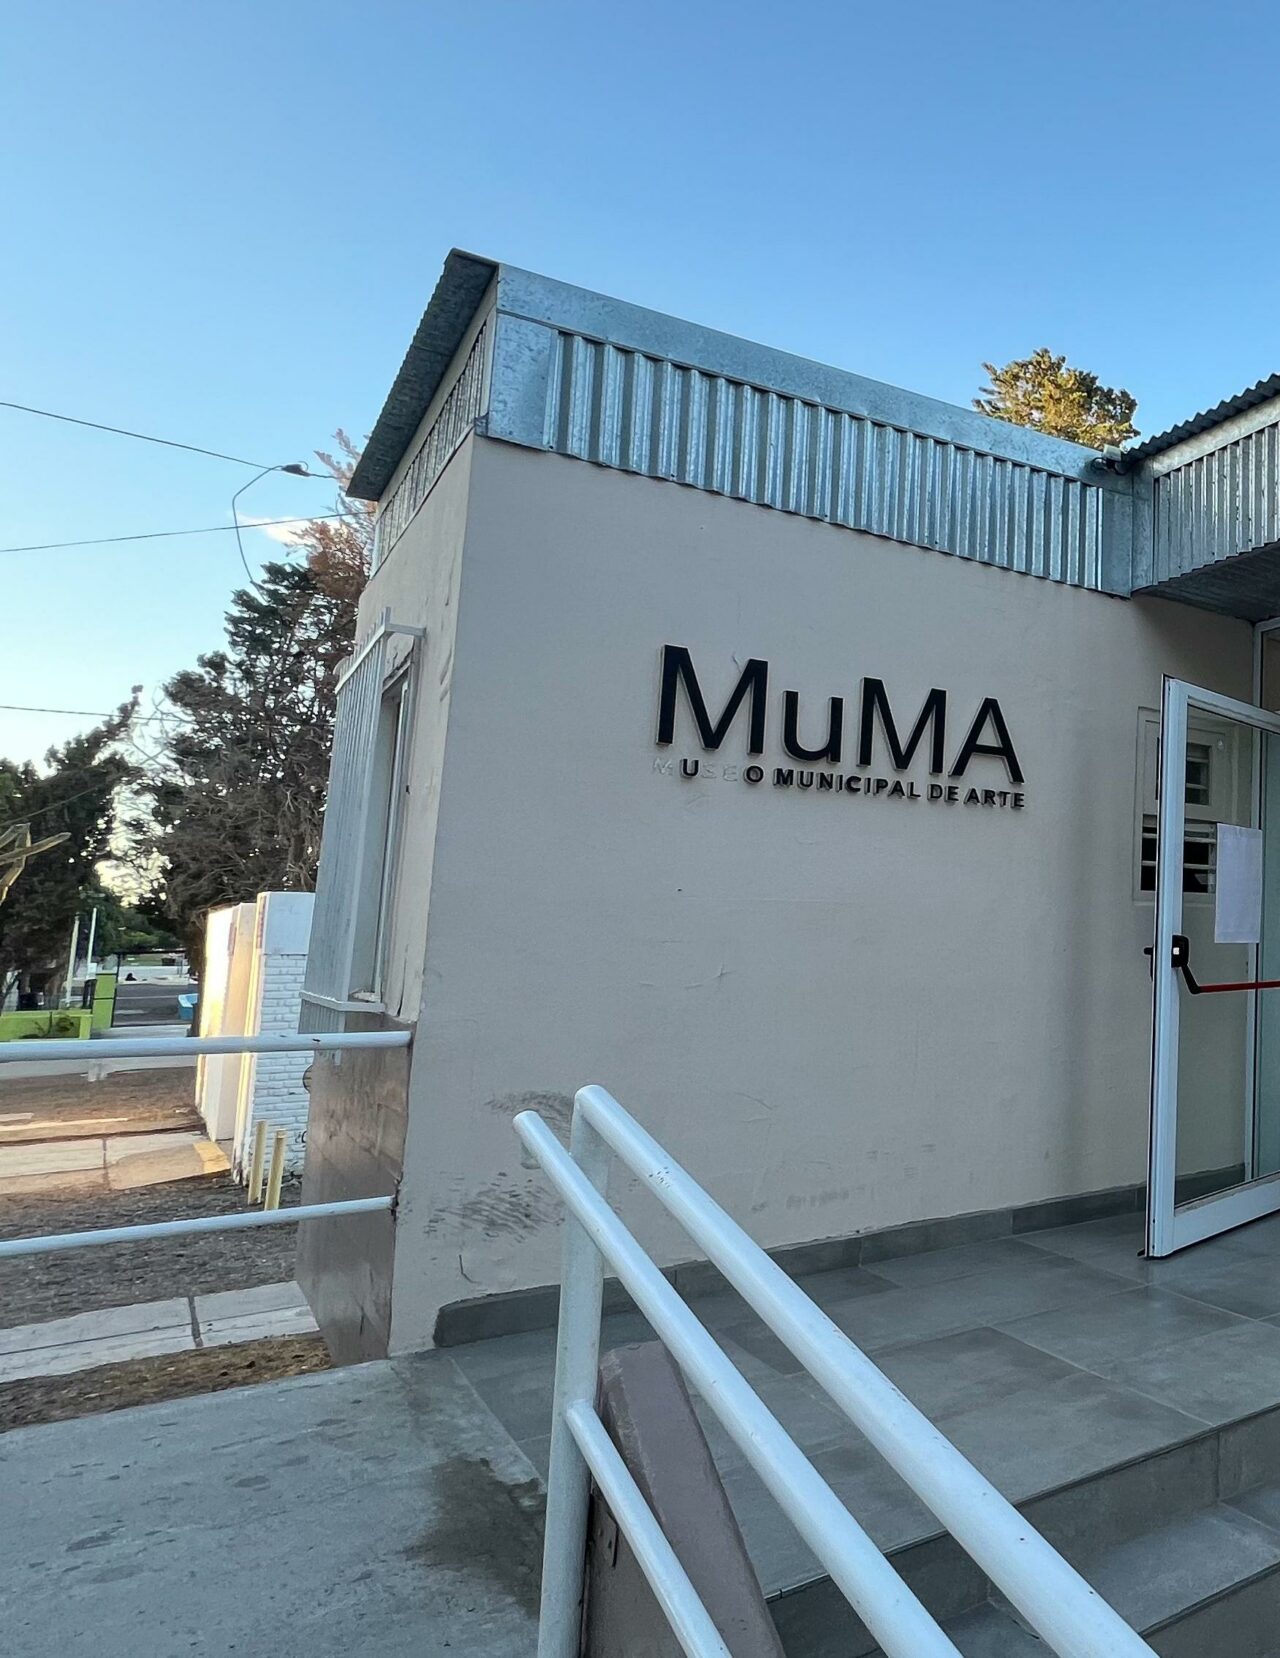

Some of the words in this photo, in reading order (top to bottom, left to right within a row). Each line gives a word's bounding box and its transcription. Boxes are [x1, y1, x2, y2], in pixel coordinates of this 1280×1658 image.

[655, 643, 1025, 784] MuMA
[773, 767, 921, 800] MUNICIPAL
[926, 783, 960, 803] DE
[963, 787, 1026, 809] ARTE
